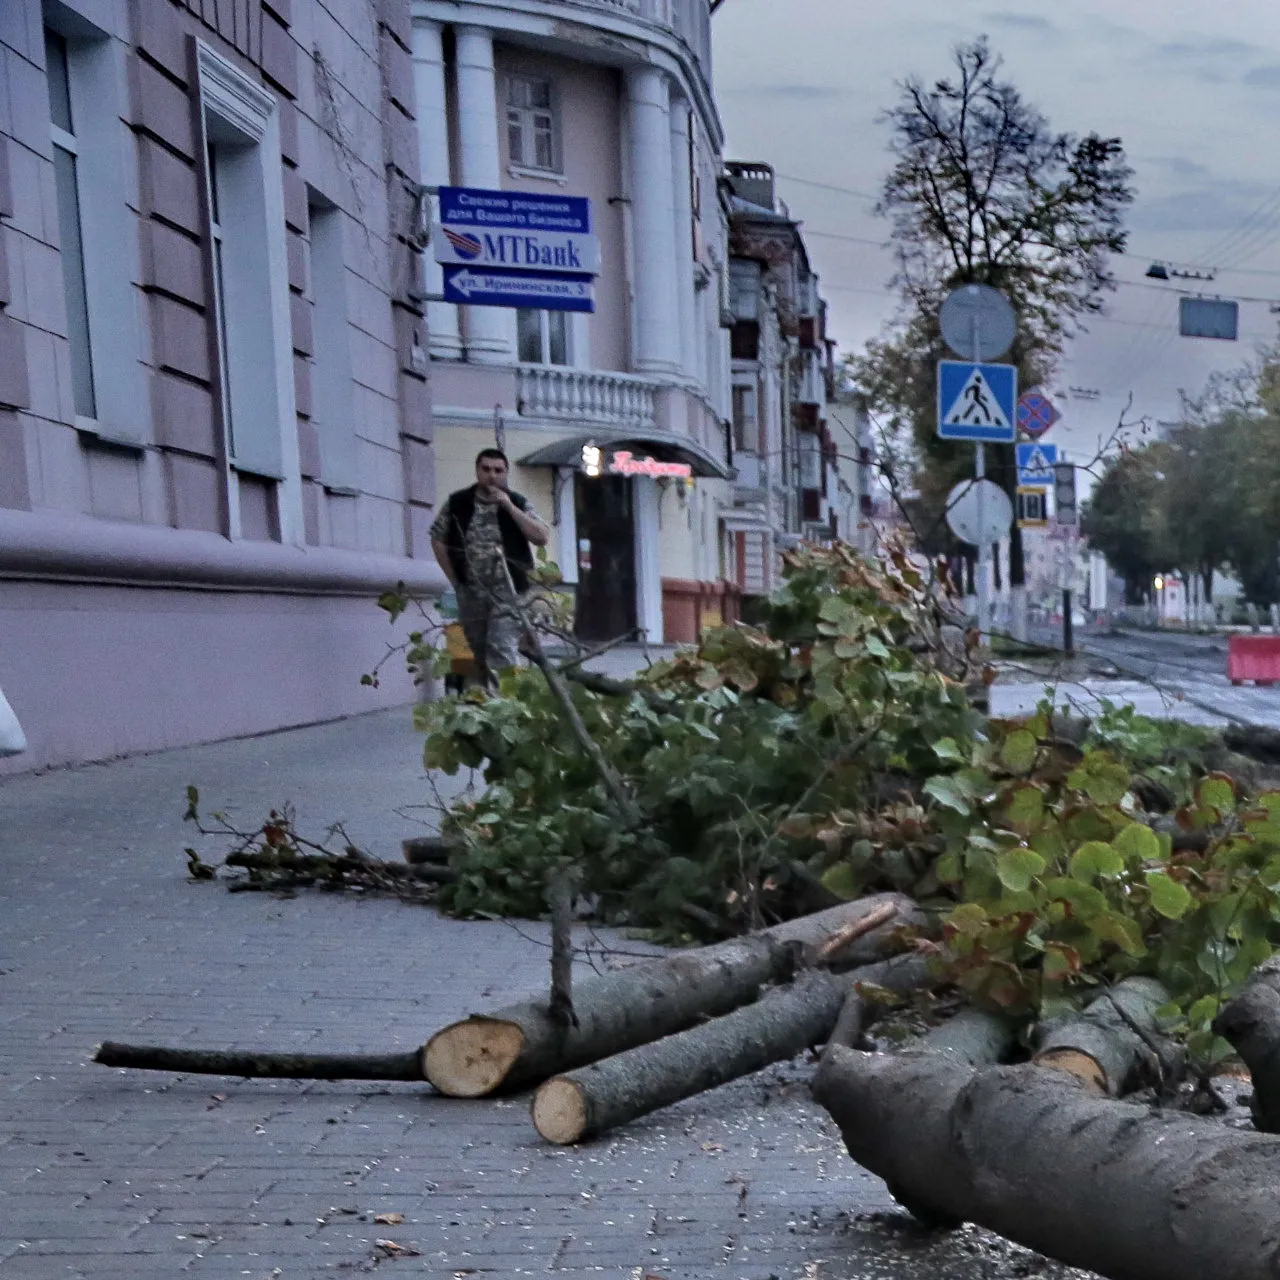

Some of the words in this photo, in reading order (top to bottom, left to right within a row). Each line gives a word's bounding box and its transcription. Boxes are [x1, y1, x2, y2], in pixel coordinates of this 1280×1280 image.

[459, 193, 509, 208] Свежие
[512, 200, 570, 212] решения
[446, 208, 473, 219] для
[476, 209, 527, 224] Вашего
[528, 212, 582, 228] бизнеса
[484, 233, 581, 268] МТБанк
[459, 277, 477, 288] ул.
